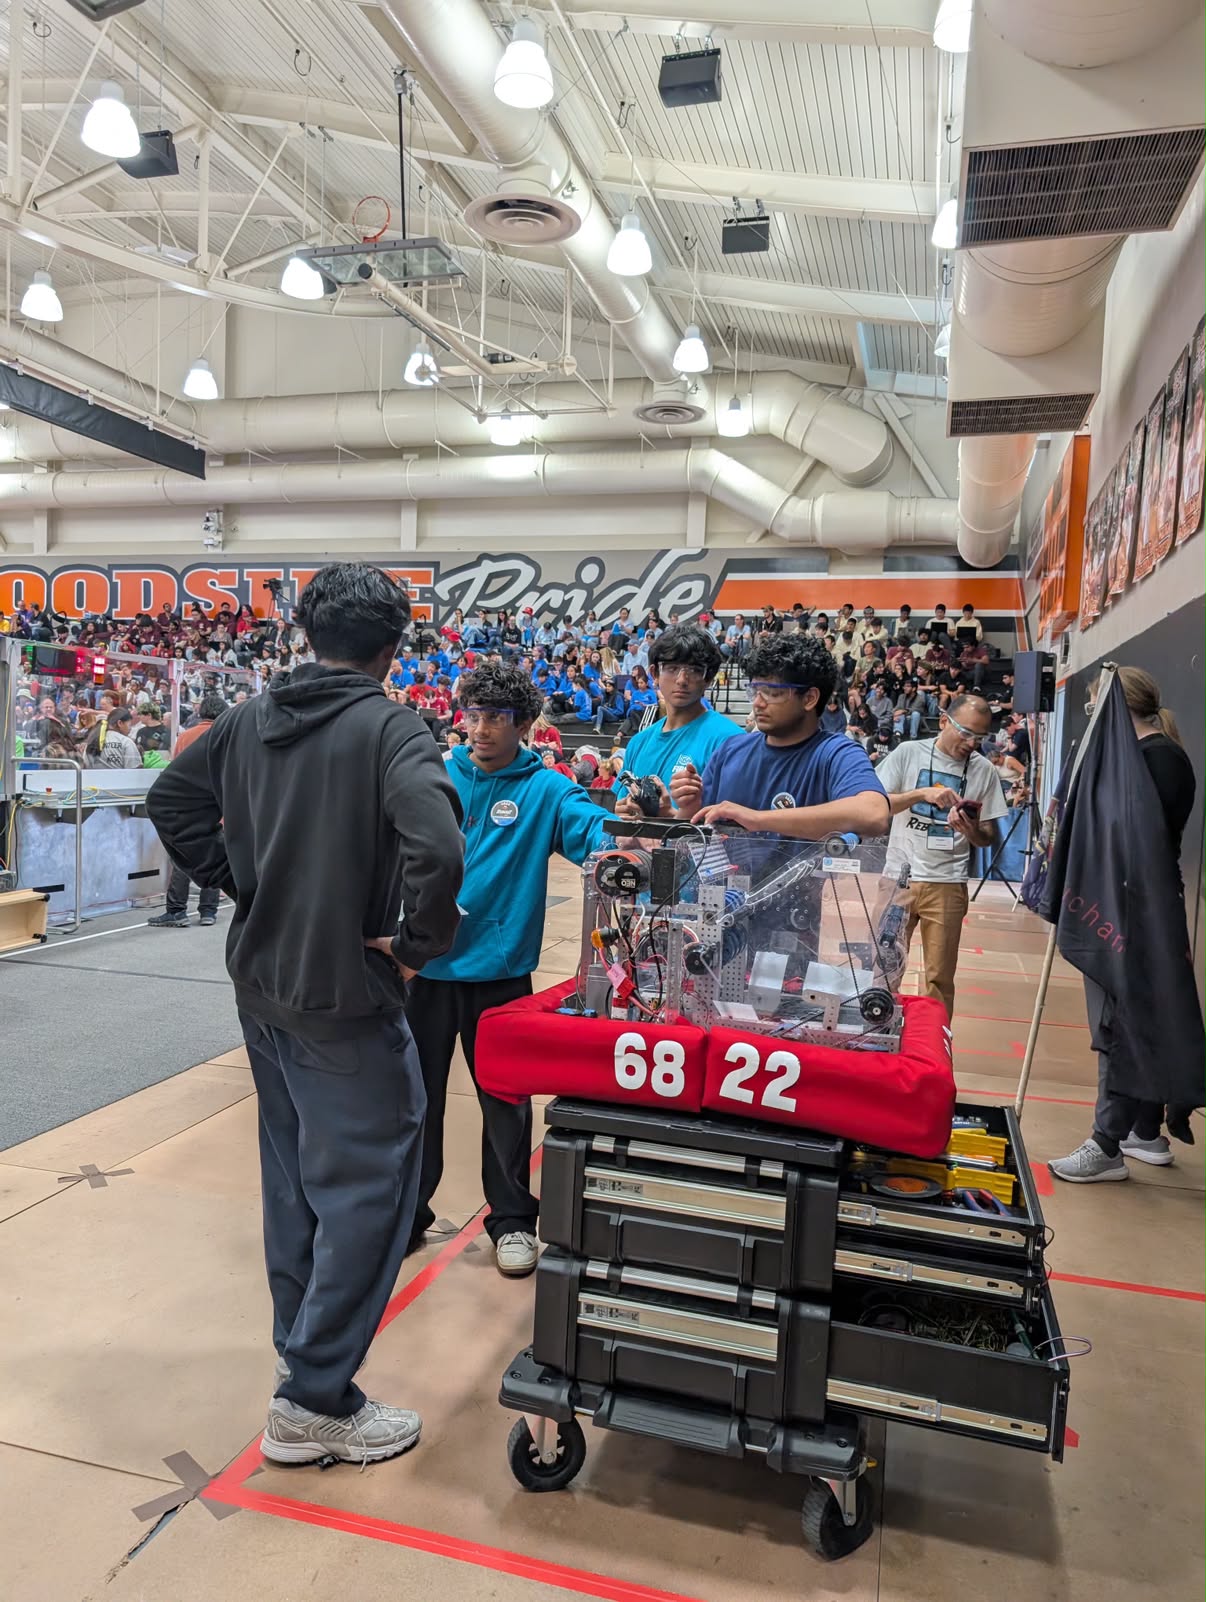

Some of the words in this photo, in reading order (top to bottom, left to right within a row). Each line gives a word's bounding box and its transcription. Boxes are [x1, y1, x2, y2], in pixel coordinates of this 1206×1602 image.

[434, 548, 705, 627] Pride
[621, 879, 636, 888] NEO
[614, 1032, 685, 1098] 68
[719, 1042, 801, 1113] 22
